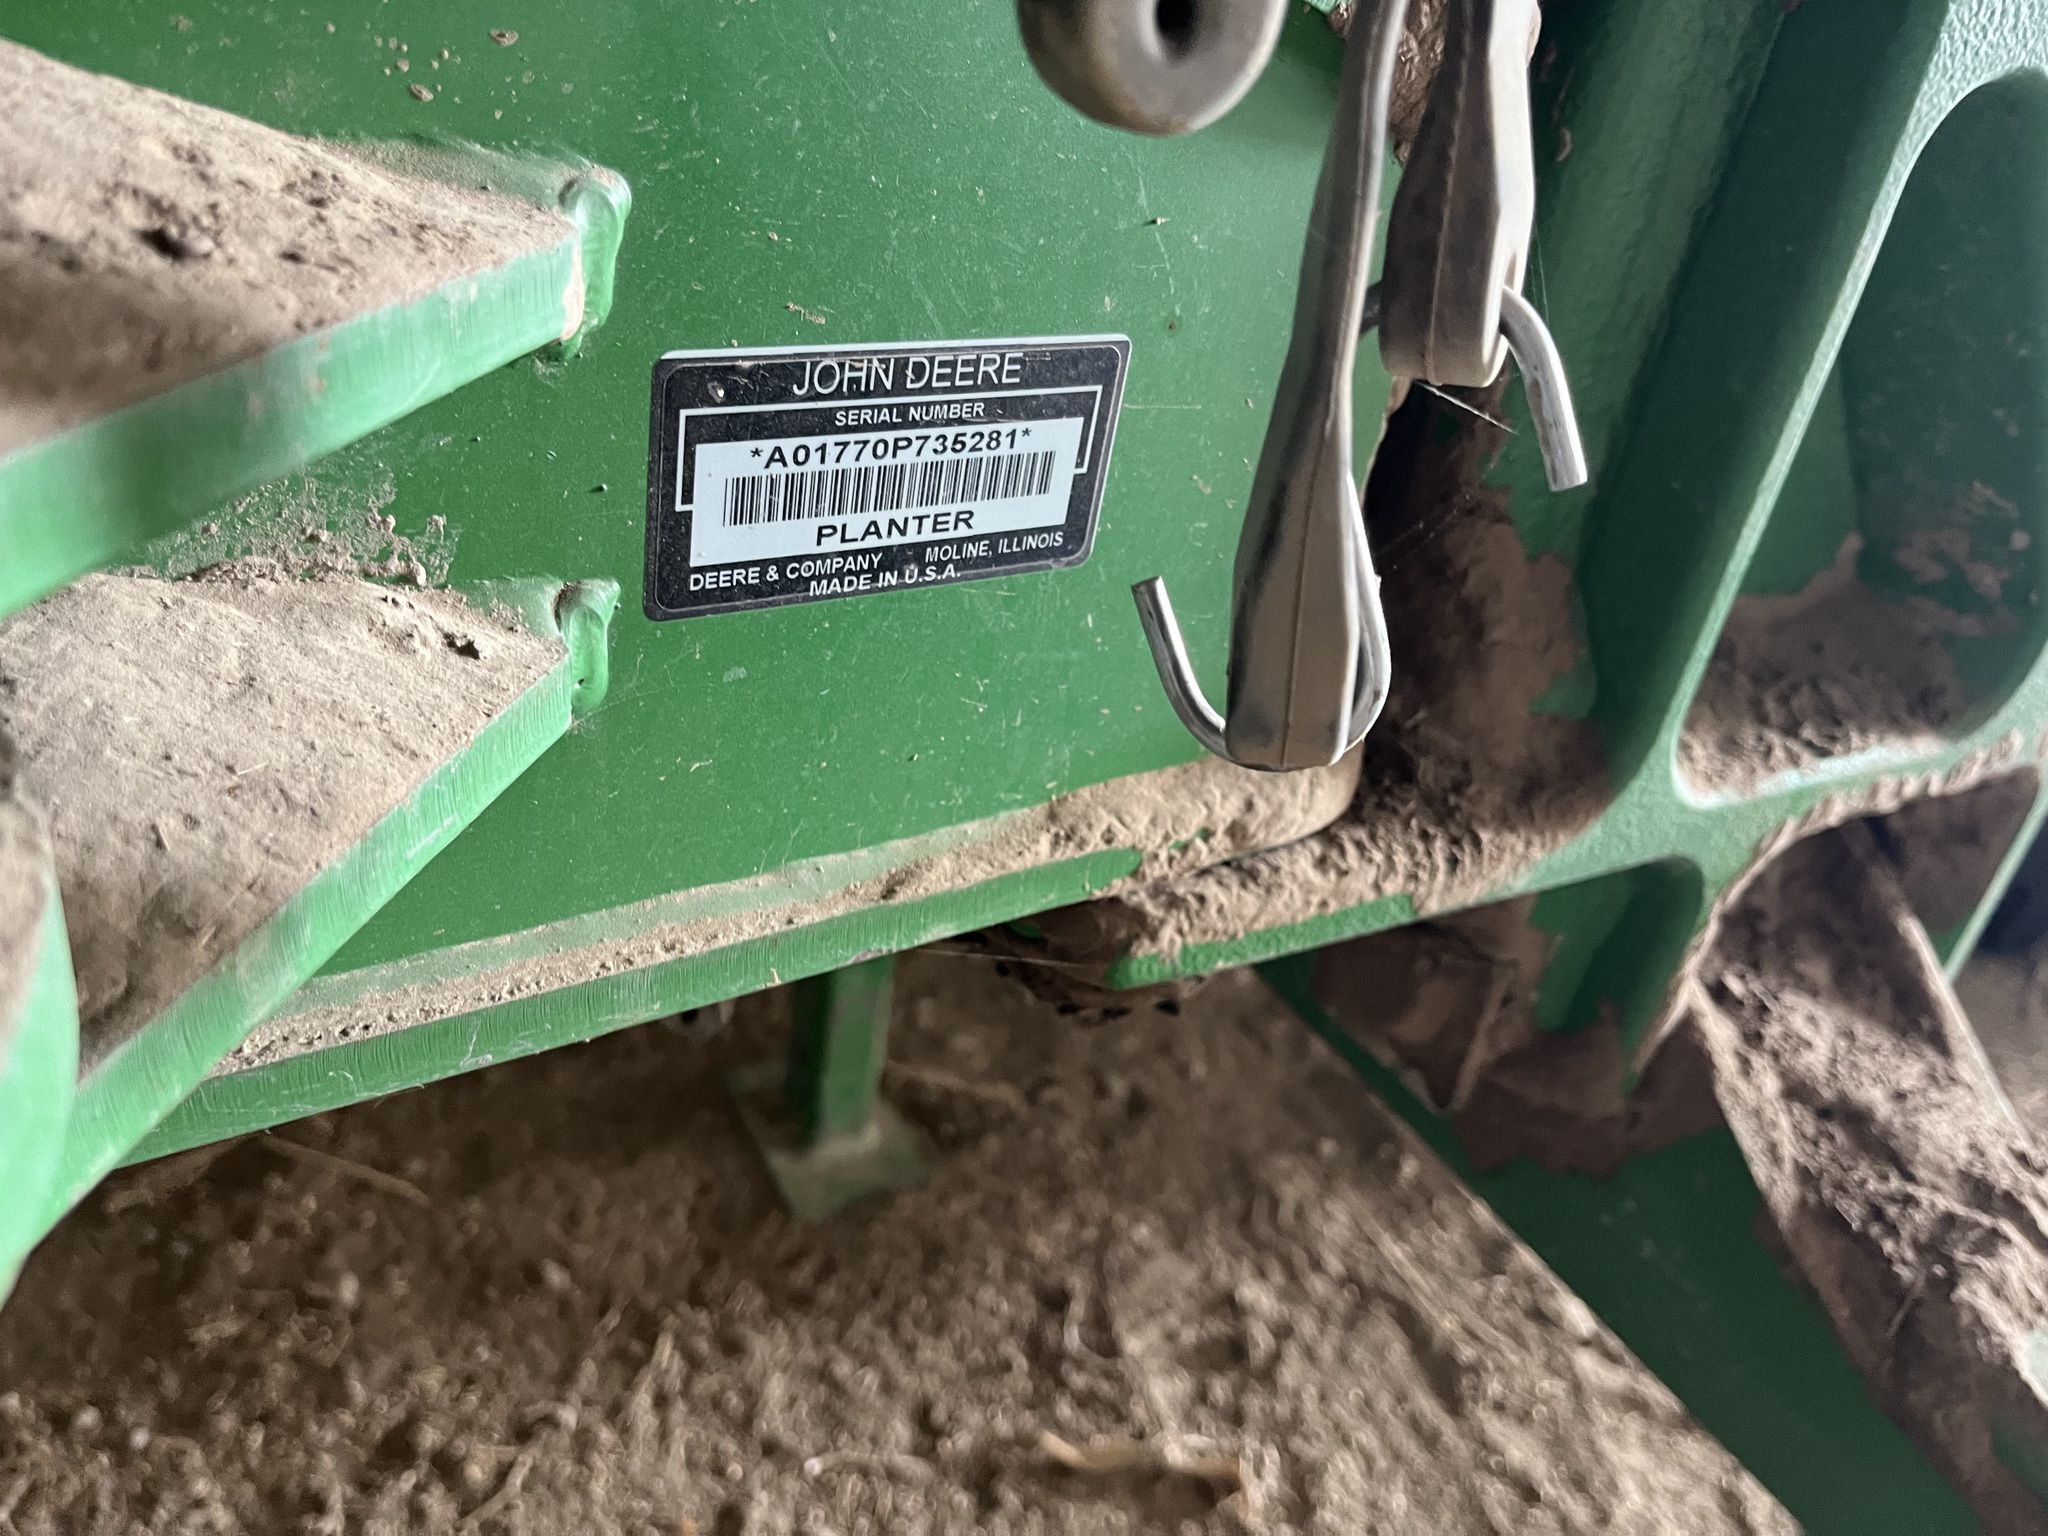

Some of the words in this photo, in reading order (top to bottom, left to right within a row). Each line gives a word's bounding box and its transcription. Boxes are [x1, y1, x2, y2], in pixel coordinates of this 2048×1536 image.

[793, 357, 895, 395] JOHN
[906, 352, 1024, 389] DEERE
[835, 407, 902, 426] SERIAL
[908, 402, 985, 421] NUMBER
[816, 509, 975, 547] PLANTER
[689, 566, 761, 591] DEERE
[766, 565, 780, 582] &
[786, 552, 883, 579] COMPANY
[925, 540, 993, 563] MOLINE,
[998, 531, 1064, 554] ILLINOIS
[809, 573, 872, 597] MADE
[878, 570, 898, 588] IN
[904, 563, 961, 585] U.S.A.
